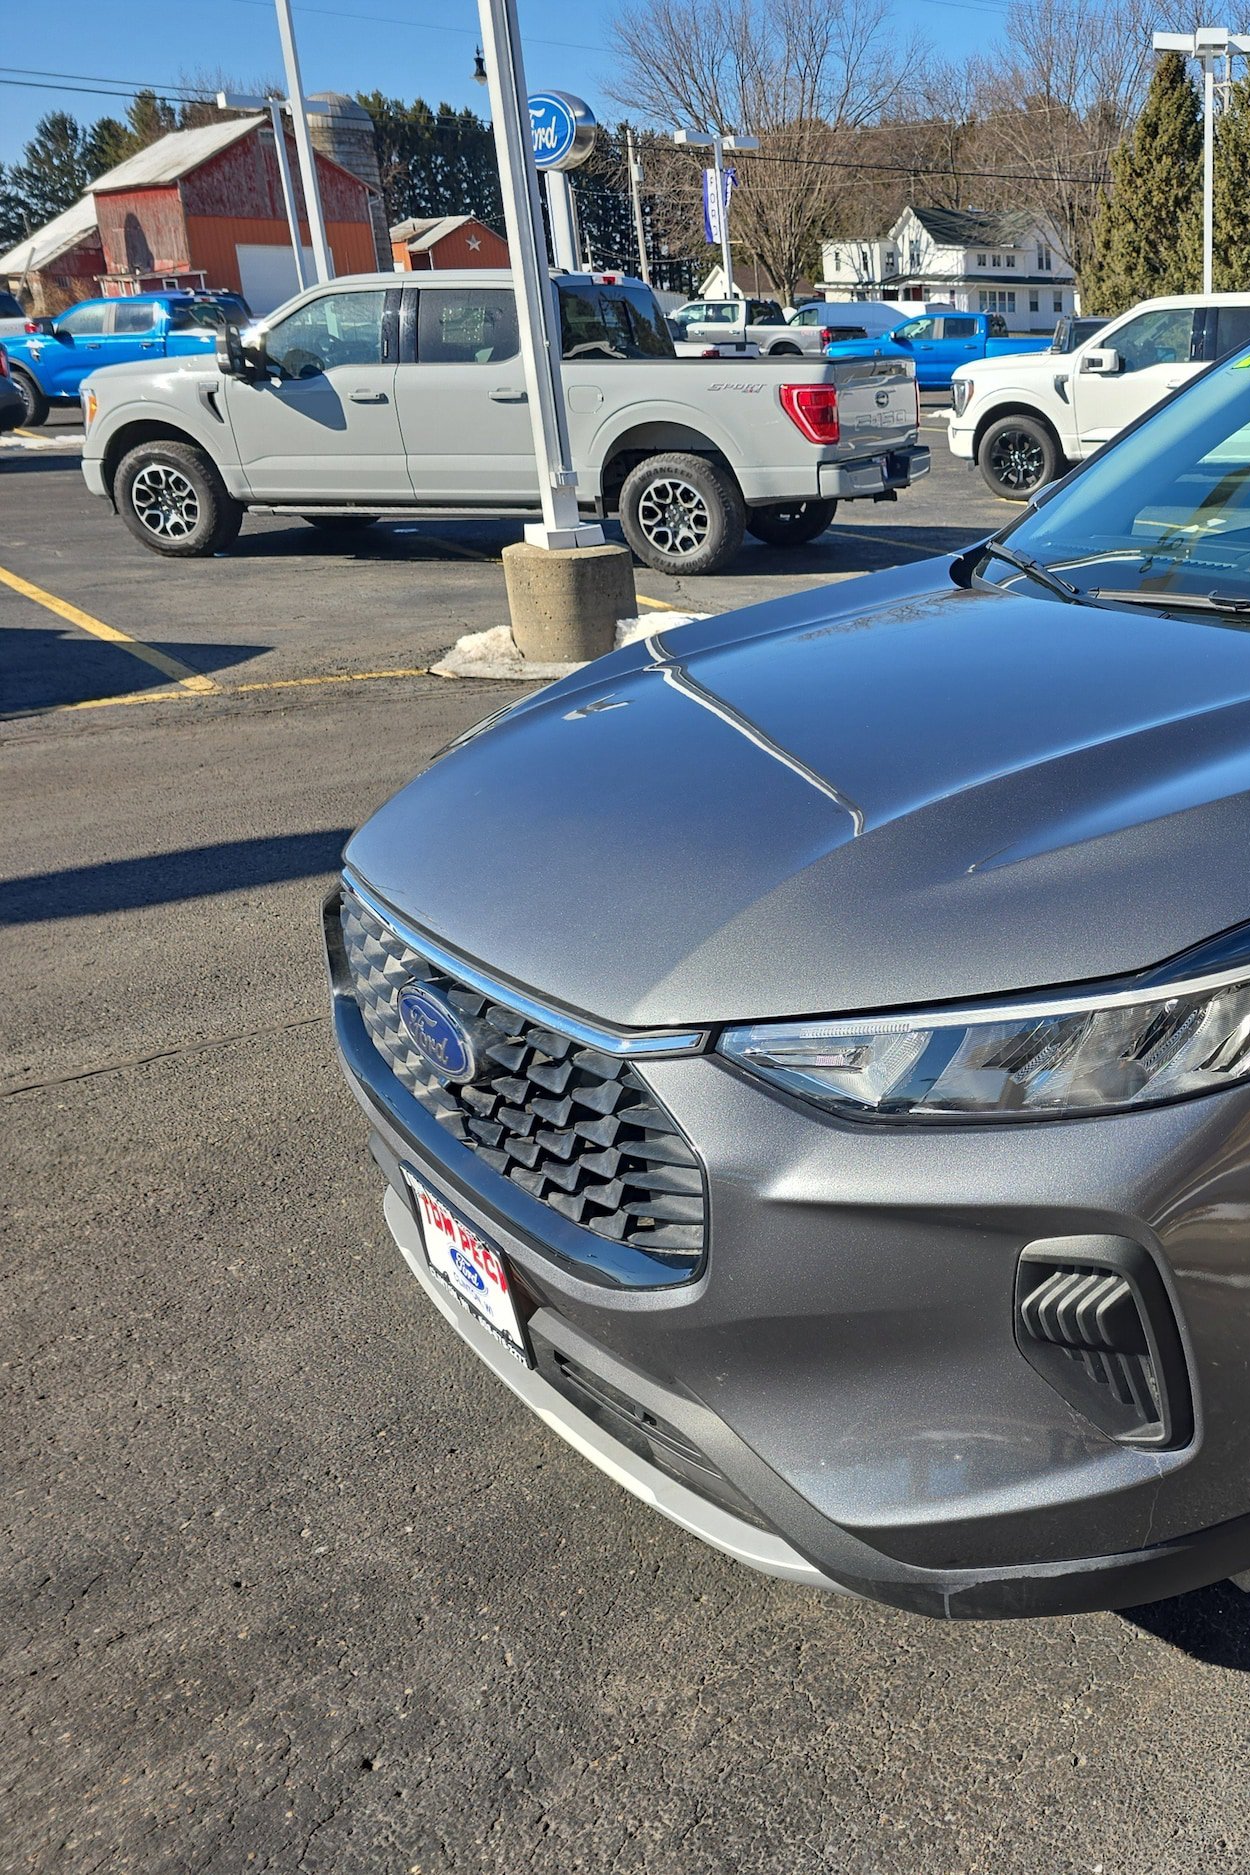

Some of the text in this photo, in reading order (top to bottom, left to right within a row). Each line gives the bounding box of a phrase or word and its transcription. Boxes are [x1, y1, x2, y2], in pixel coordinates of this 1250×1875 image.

[410, 1004, 448, 1065] Ford
[418, 1193, 457, 1243] TOM
[455, 1252, 481, 1287] Ford
